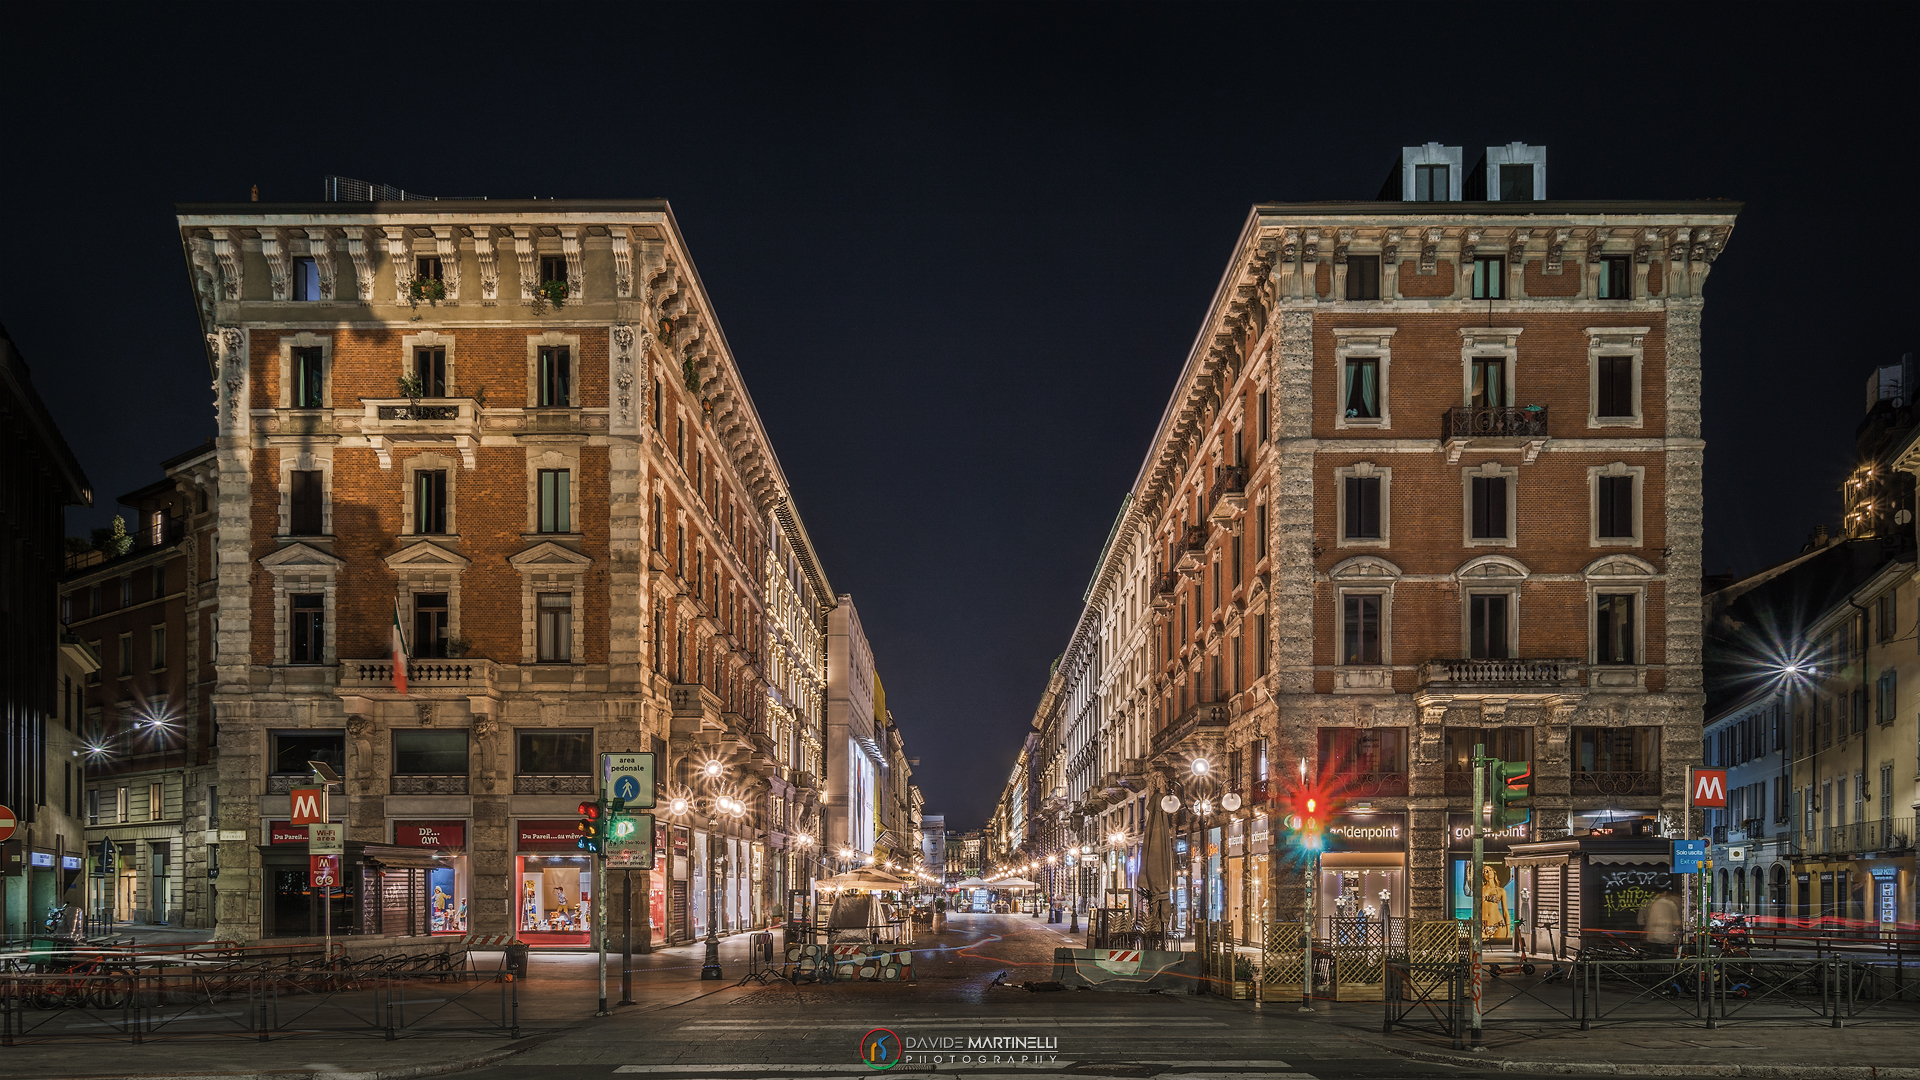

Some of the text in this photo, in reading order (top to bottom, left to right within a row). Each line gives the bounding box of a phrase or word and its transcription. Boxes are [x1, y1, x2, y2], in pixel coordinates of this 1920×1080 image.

[1695, 776, 1724, 800] M
[293, 795, 319, 818] M
[421, 836, 440, 844] am
[1455, 825, 1525, 840] golenpoint
